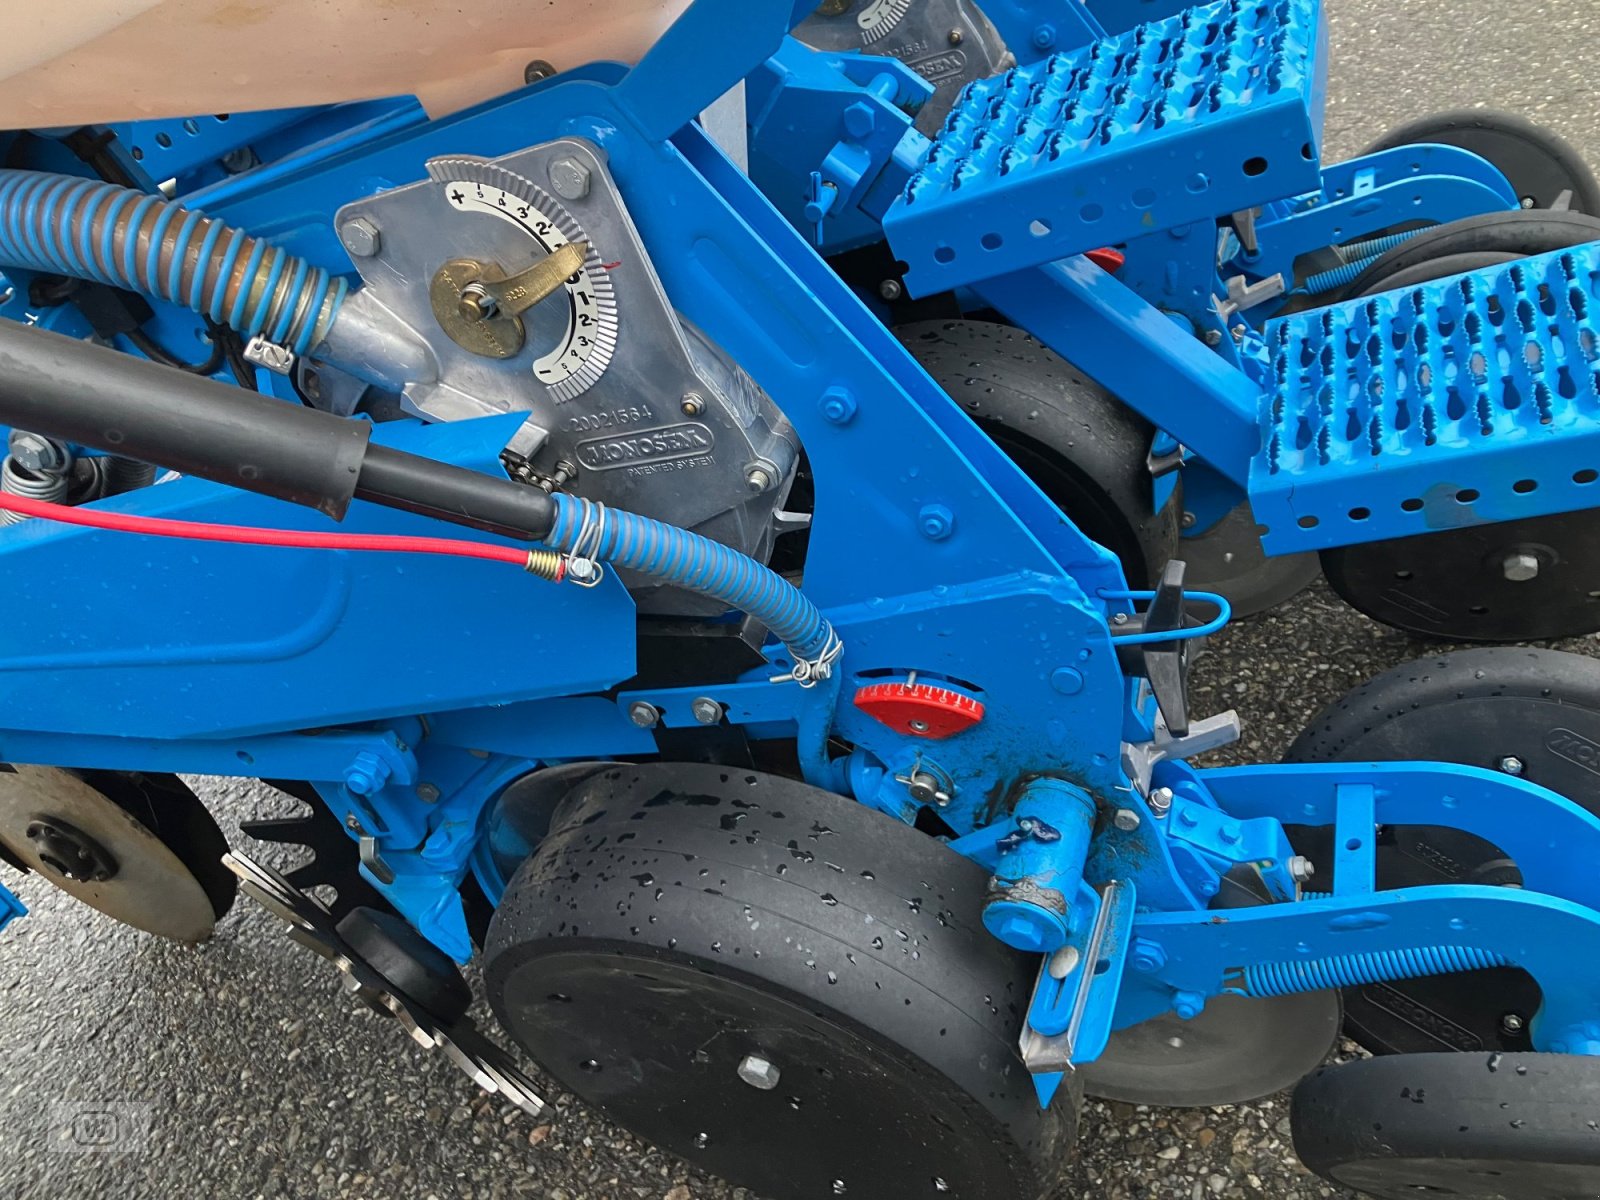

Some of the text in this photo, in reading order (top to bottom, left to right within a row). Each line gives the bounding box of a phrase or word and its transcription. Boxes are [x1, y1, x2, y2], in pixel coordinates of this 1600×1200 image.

[477, 191, 484, 199] 5
[498, 198, 506, 207] 4
[516, 206, 528, 219] 3
[535, 221, 550, 236] 2
[577, 291, 590, 306] 1
[578, 313, 593, 327] 2
[577, 335, 589, 347] 3
[570, 349, 579, 358] 4
[569, 404, 653, 432] 20021564
[586, 429, 708, 464] MONOSEM
[627, 455, 717, 477] PATENTED SYSTEM
